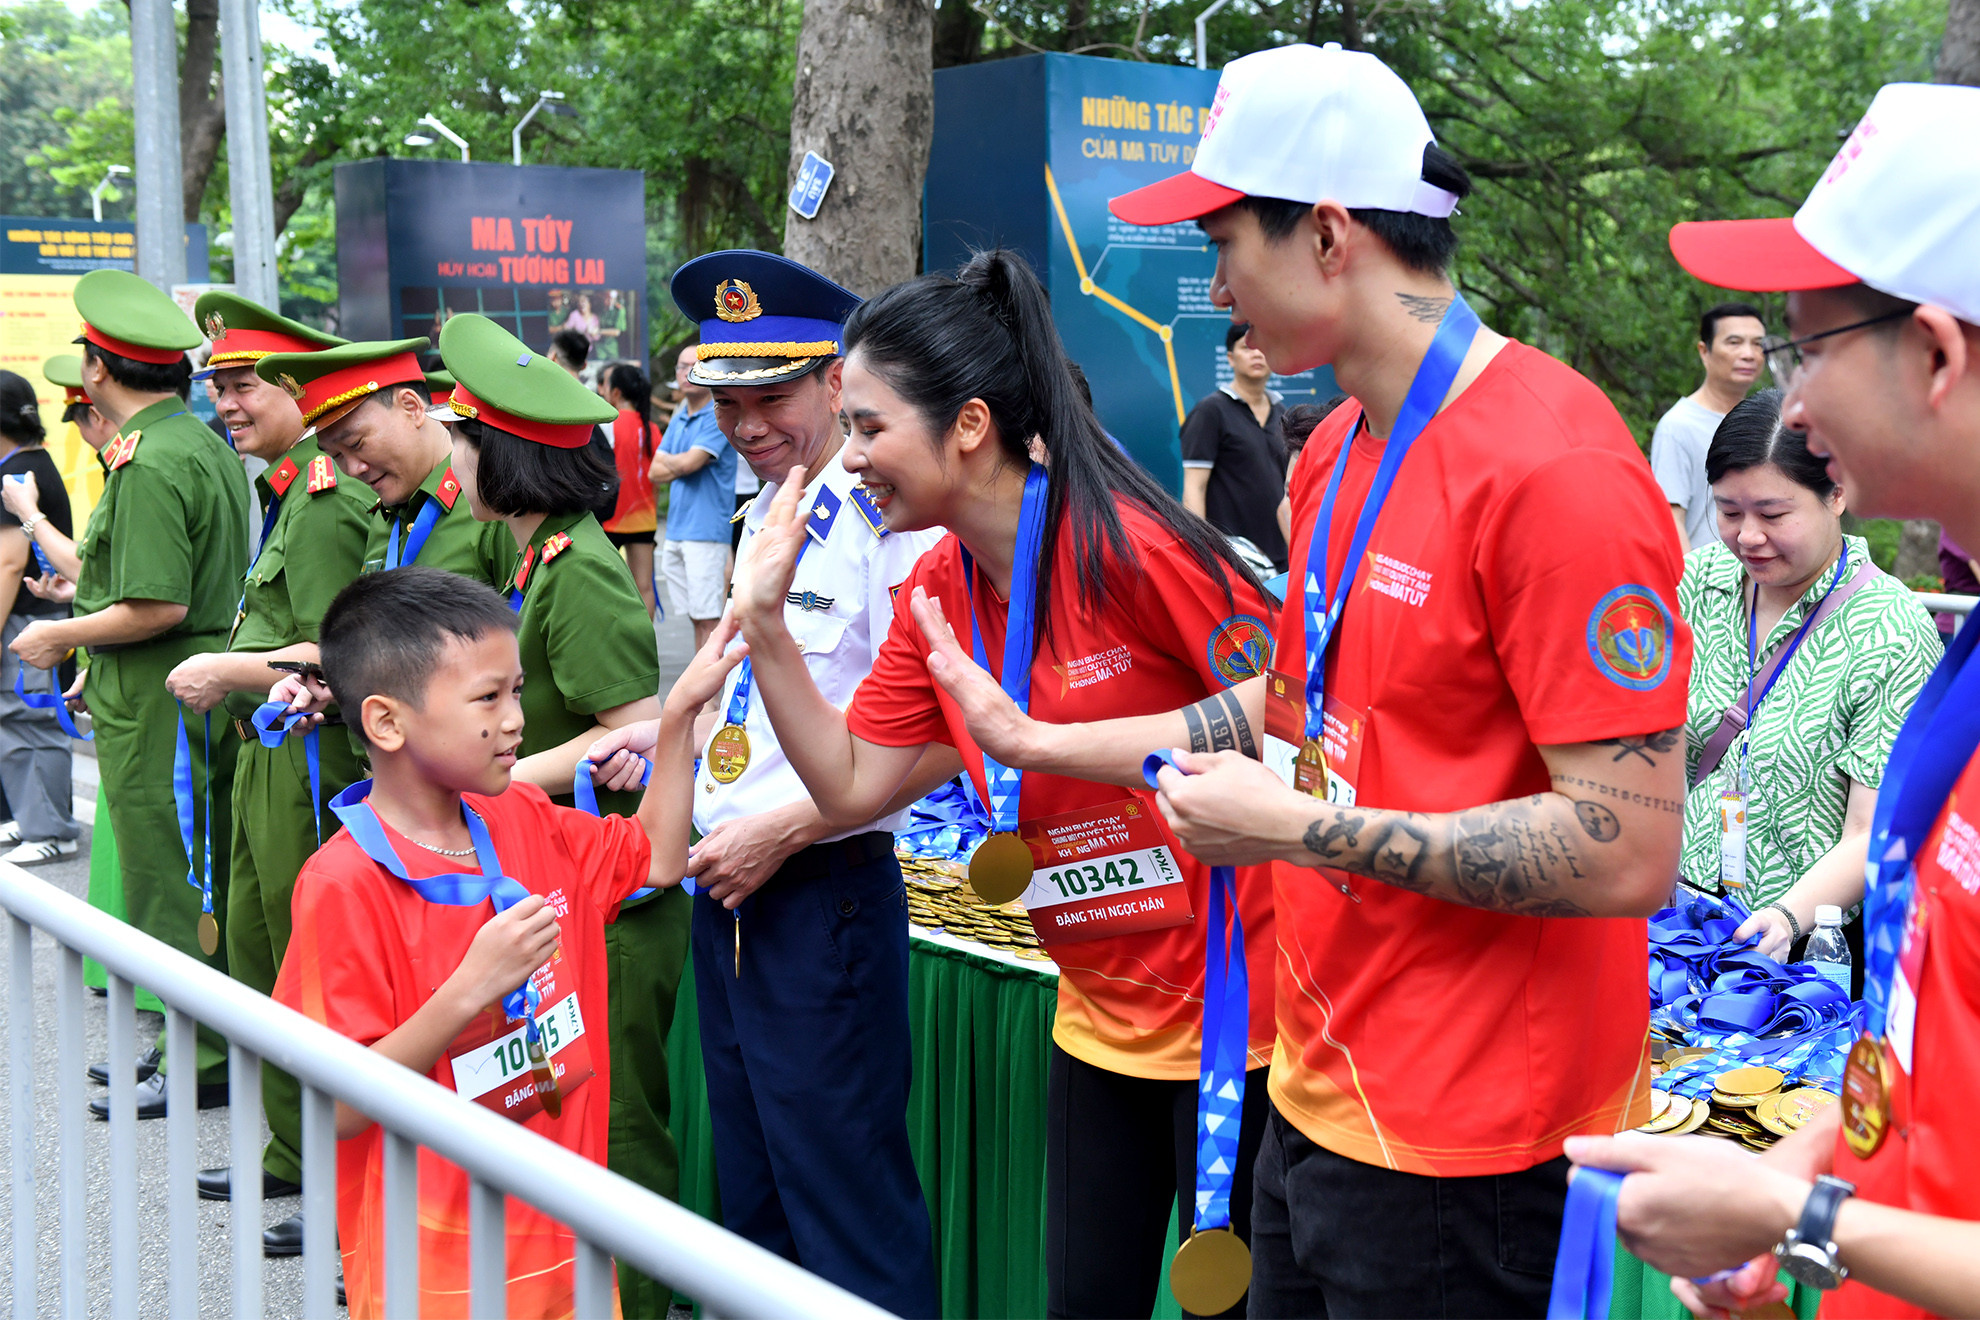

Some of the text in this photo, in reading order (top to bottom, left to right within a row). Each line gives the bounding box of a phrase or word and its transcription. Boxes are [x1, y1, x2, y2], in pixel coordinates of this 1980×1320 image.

[1081, 95, 1150, 131] NHỮNG
[1155, 100, 1193, 134] TÁC
[1081, 133, 1117, 160] CỦA
[1121, 140, 1145, 161] MA
[471, 214, 573, 253] MA TÚY
[499, 253, 570, 284] TƯƠNG
[574, 258, 605, 285] LAI
[1096, 667, 1114, 681] MA
[1211, 715, 1232, 748] 197
[1087, 837, 1108, 850] MA
[1049, 858, 1145, 898] 10342
[1152, 848, 1175, 882] 1.7KM
[1055, 897, 1165, 927] ĐẶNG THỊ NGỌC HÂN
[505, 1083, 534, 1109] ĐẶNG
